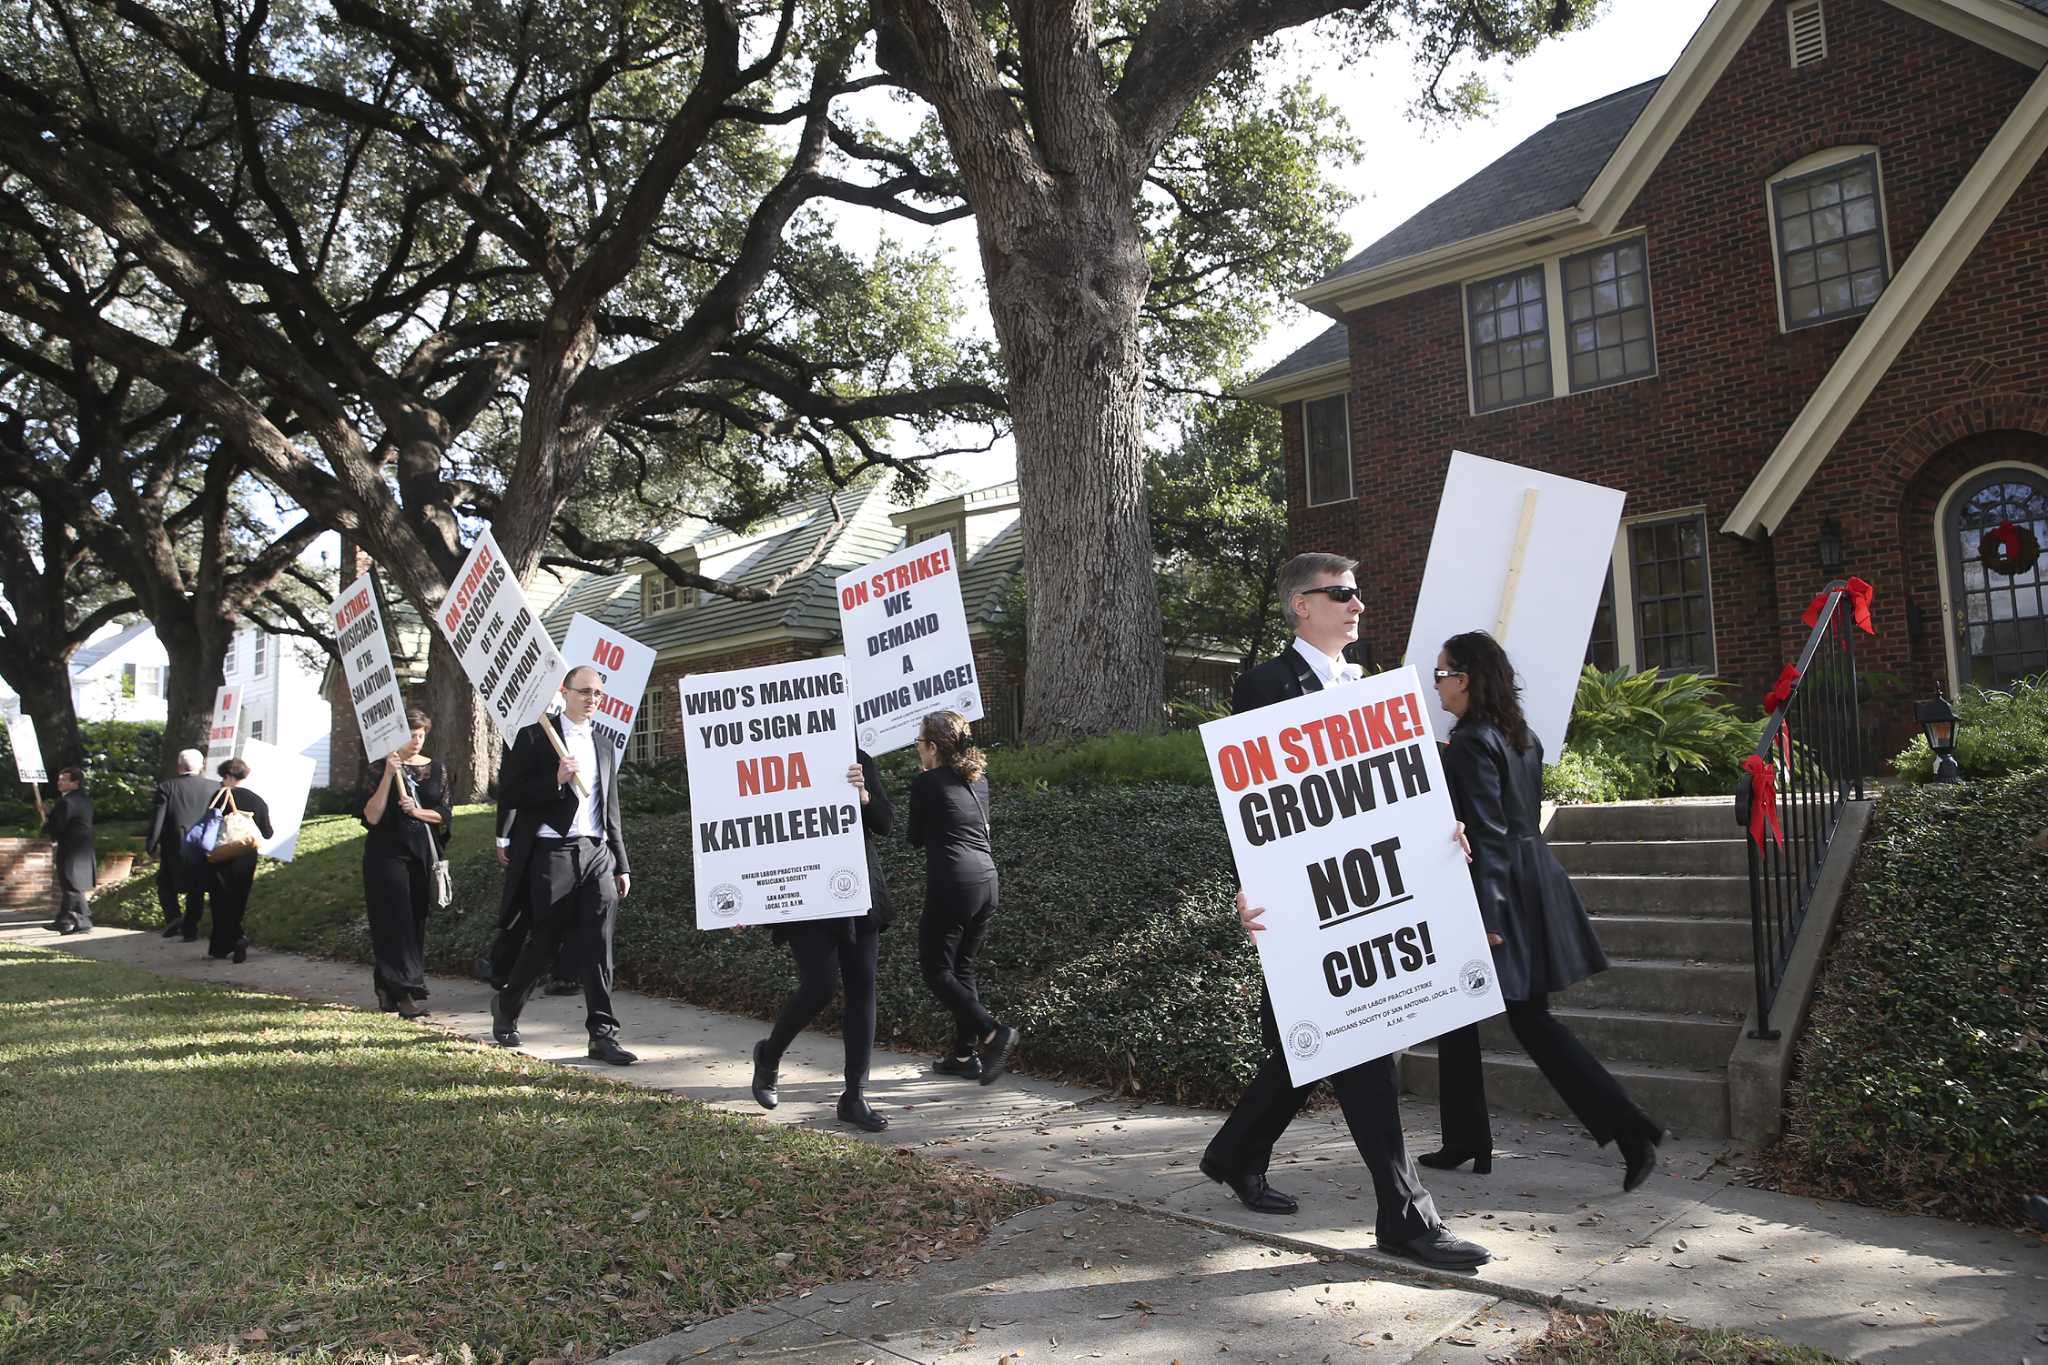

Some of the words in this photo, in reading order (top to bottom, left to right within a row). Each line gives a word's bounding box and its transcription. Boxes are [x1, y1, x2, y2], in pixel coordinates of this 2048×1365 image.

[445, 602, 462, 633] ON
[456, 544, 493, 611] STRIKE!
[841, 581, 868, 611] ON
[871, 548, 951, 602] STRIKE!
[452, 559, 506, 659] MUSICIANS
[883, 590, 913, 618] WE
[339, 609, 378, 656] MUSICIANS
[479, 666, 500, 701] SAN
[494, 607, 532, 674] ANTONIO
[481, 633, 492, 655] OF
[488, 611, 505, 639] THE
[592, 638, 625, 671] NO
[866, 612, 940, 657] DEMAND
[352, 683, 366, 705] SAN
[364, 664, 391, 698] ANTONIO
[496, 636, 542, 719] SYMPHONY
[902, 654, 914, 674] A
[361, 694, 396, 730] SYMPHONY
[596, 693, 634, 724] AITH
[684, 685, 755, 716] WHO'S
[760, 672, 845, 705] MAKING
[854, 686, 912, 725] LIVING
[913, 663, 974, 703] WAGE!
[700, 721, 744, 749] YOU
[749, 712, 807, 742] SIGN
[806, 708, 837, 734] AN
[1218, 735, 1277, 792] ON
[1279, 692, 1425, 774] STRIKE!
[736, 751, 812, 797] NDA
[1238, 744, 1432, 846] GROWTH
[700, 804, 858, 853] KATHLEEN?
[1305, 836, 1406, 922] NOT
[1322, 921, 1437, 998] CUTS!
[1325, 1022, 1358, 1038] MUSICIANS
[1358, 1013, 1381, 1027] SOCIETY
[1382, 1009, 1391, 1018] OF
[1391, 1006, 1403, 1015] SAN
[1432, 989, 1449, 1000] LOCAL
[1345, 1003, 1367, 1016] UNFAIR
[1367, 997, 1387, 1009] LABOR
[1387, 988, 1413, 1002] PRACTICE
[1414, 980, 1433, 993] STRIKE
